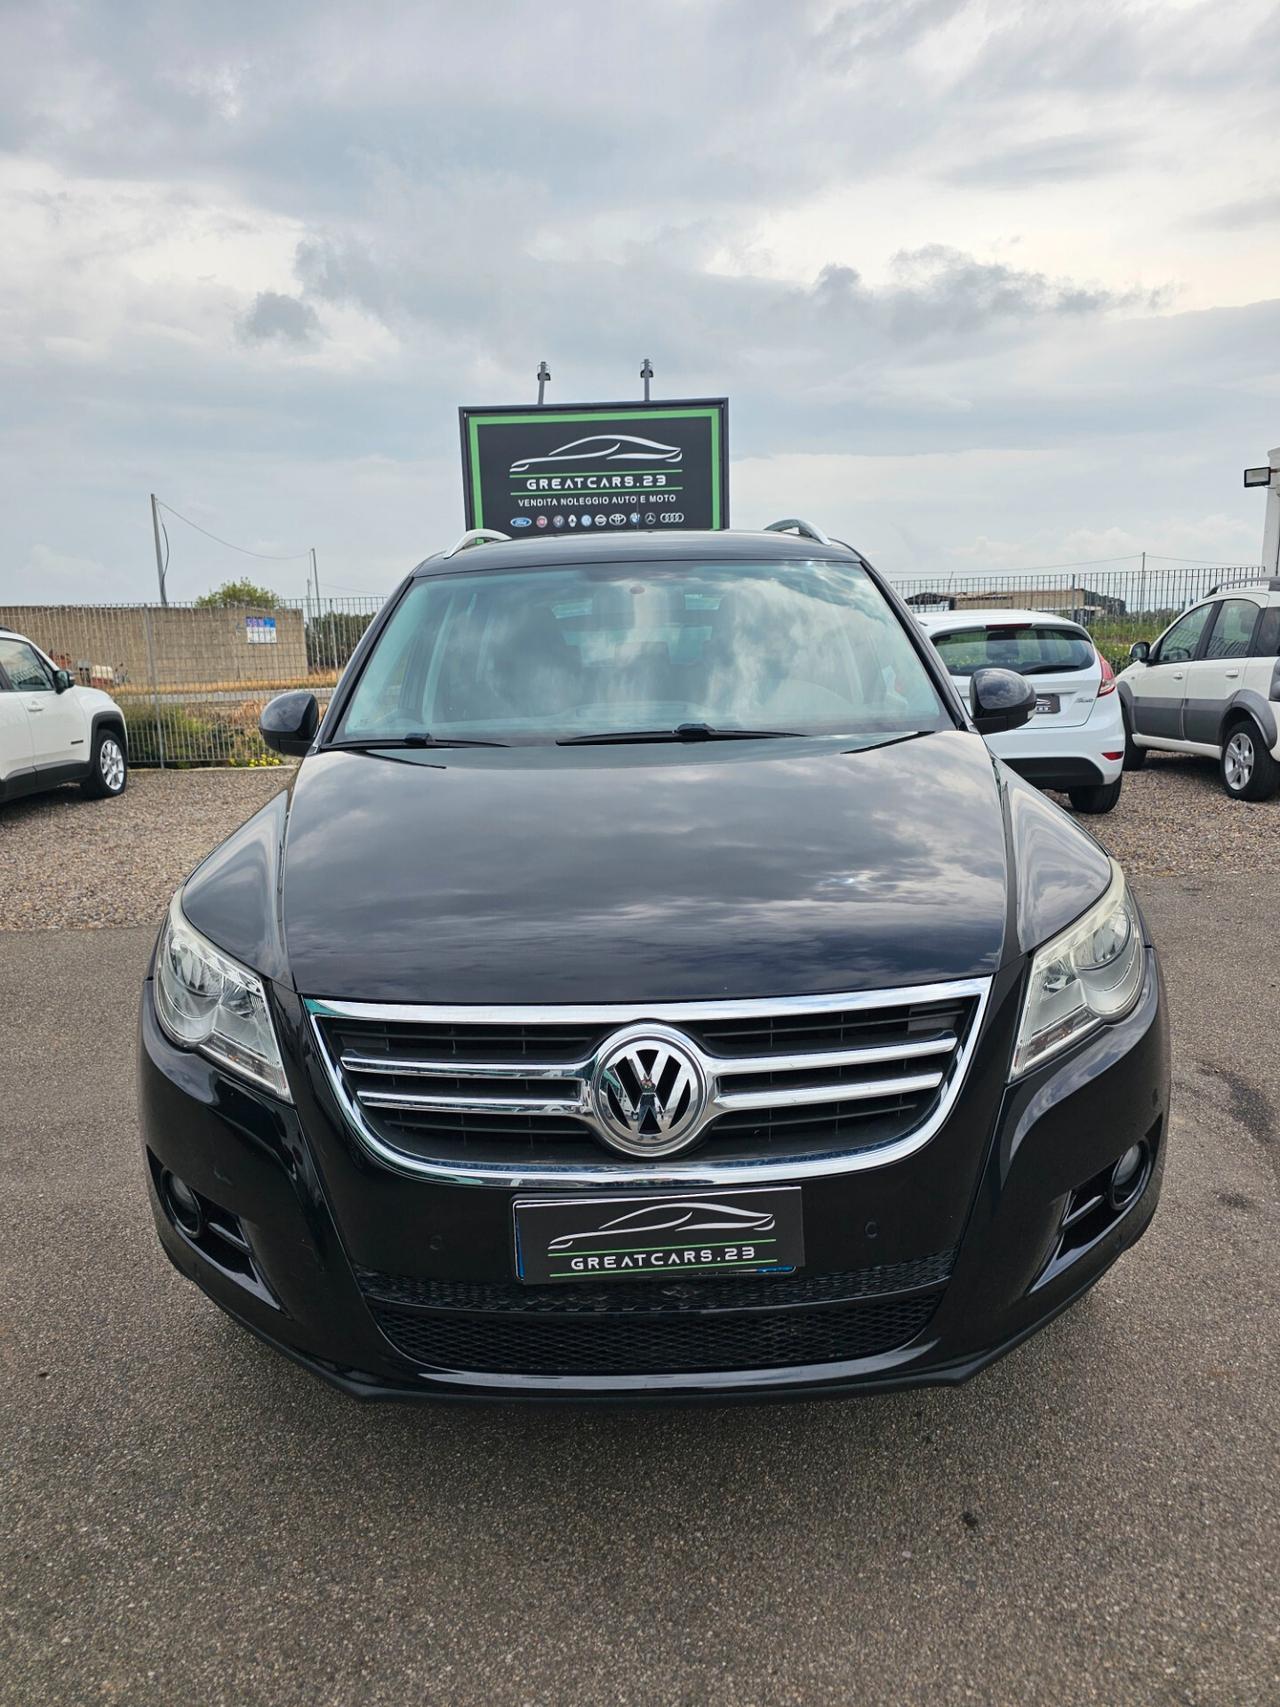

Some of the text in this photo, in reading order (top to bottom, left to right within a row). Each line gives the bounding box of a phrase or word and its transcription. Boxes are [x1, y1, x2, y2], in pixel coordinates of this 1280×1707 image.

[526, 475, 667, 490] GREATCARS.23
[518, 494, 676, 507] VENDITA NOLEGGIO AUTO E MOTO
[571, 1246, 756, 1271] GREATCARS.23
